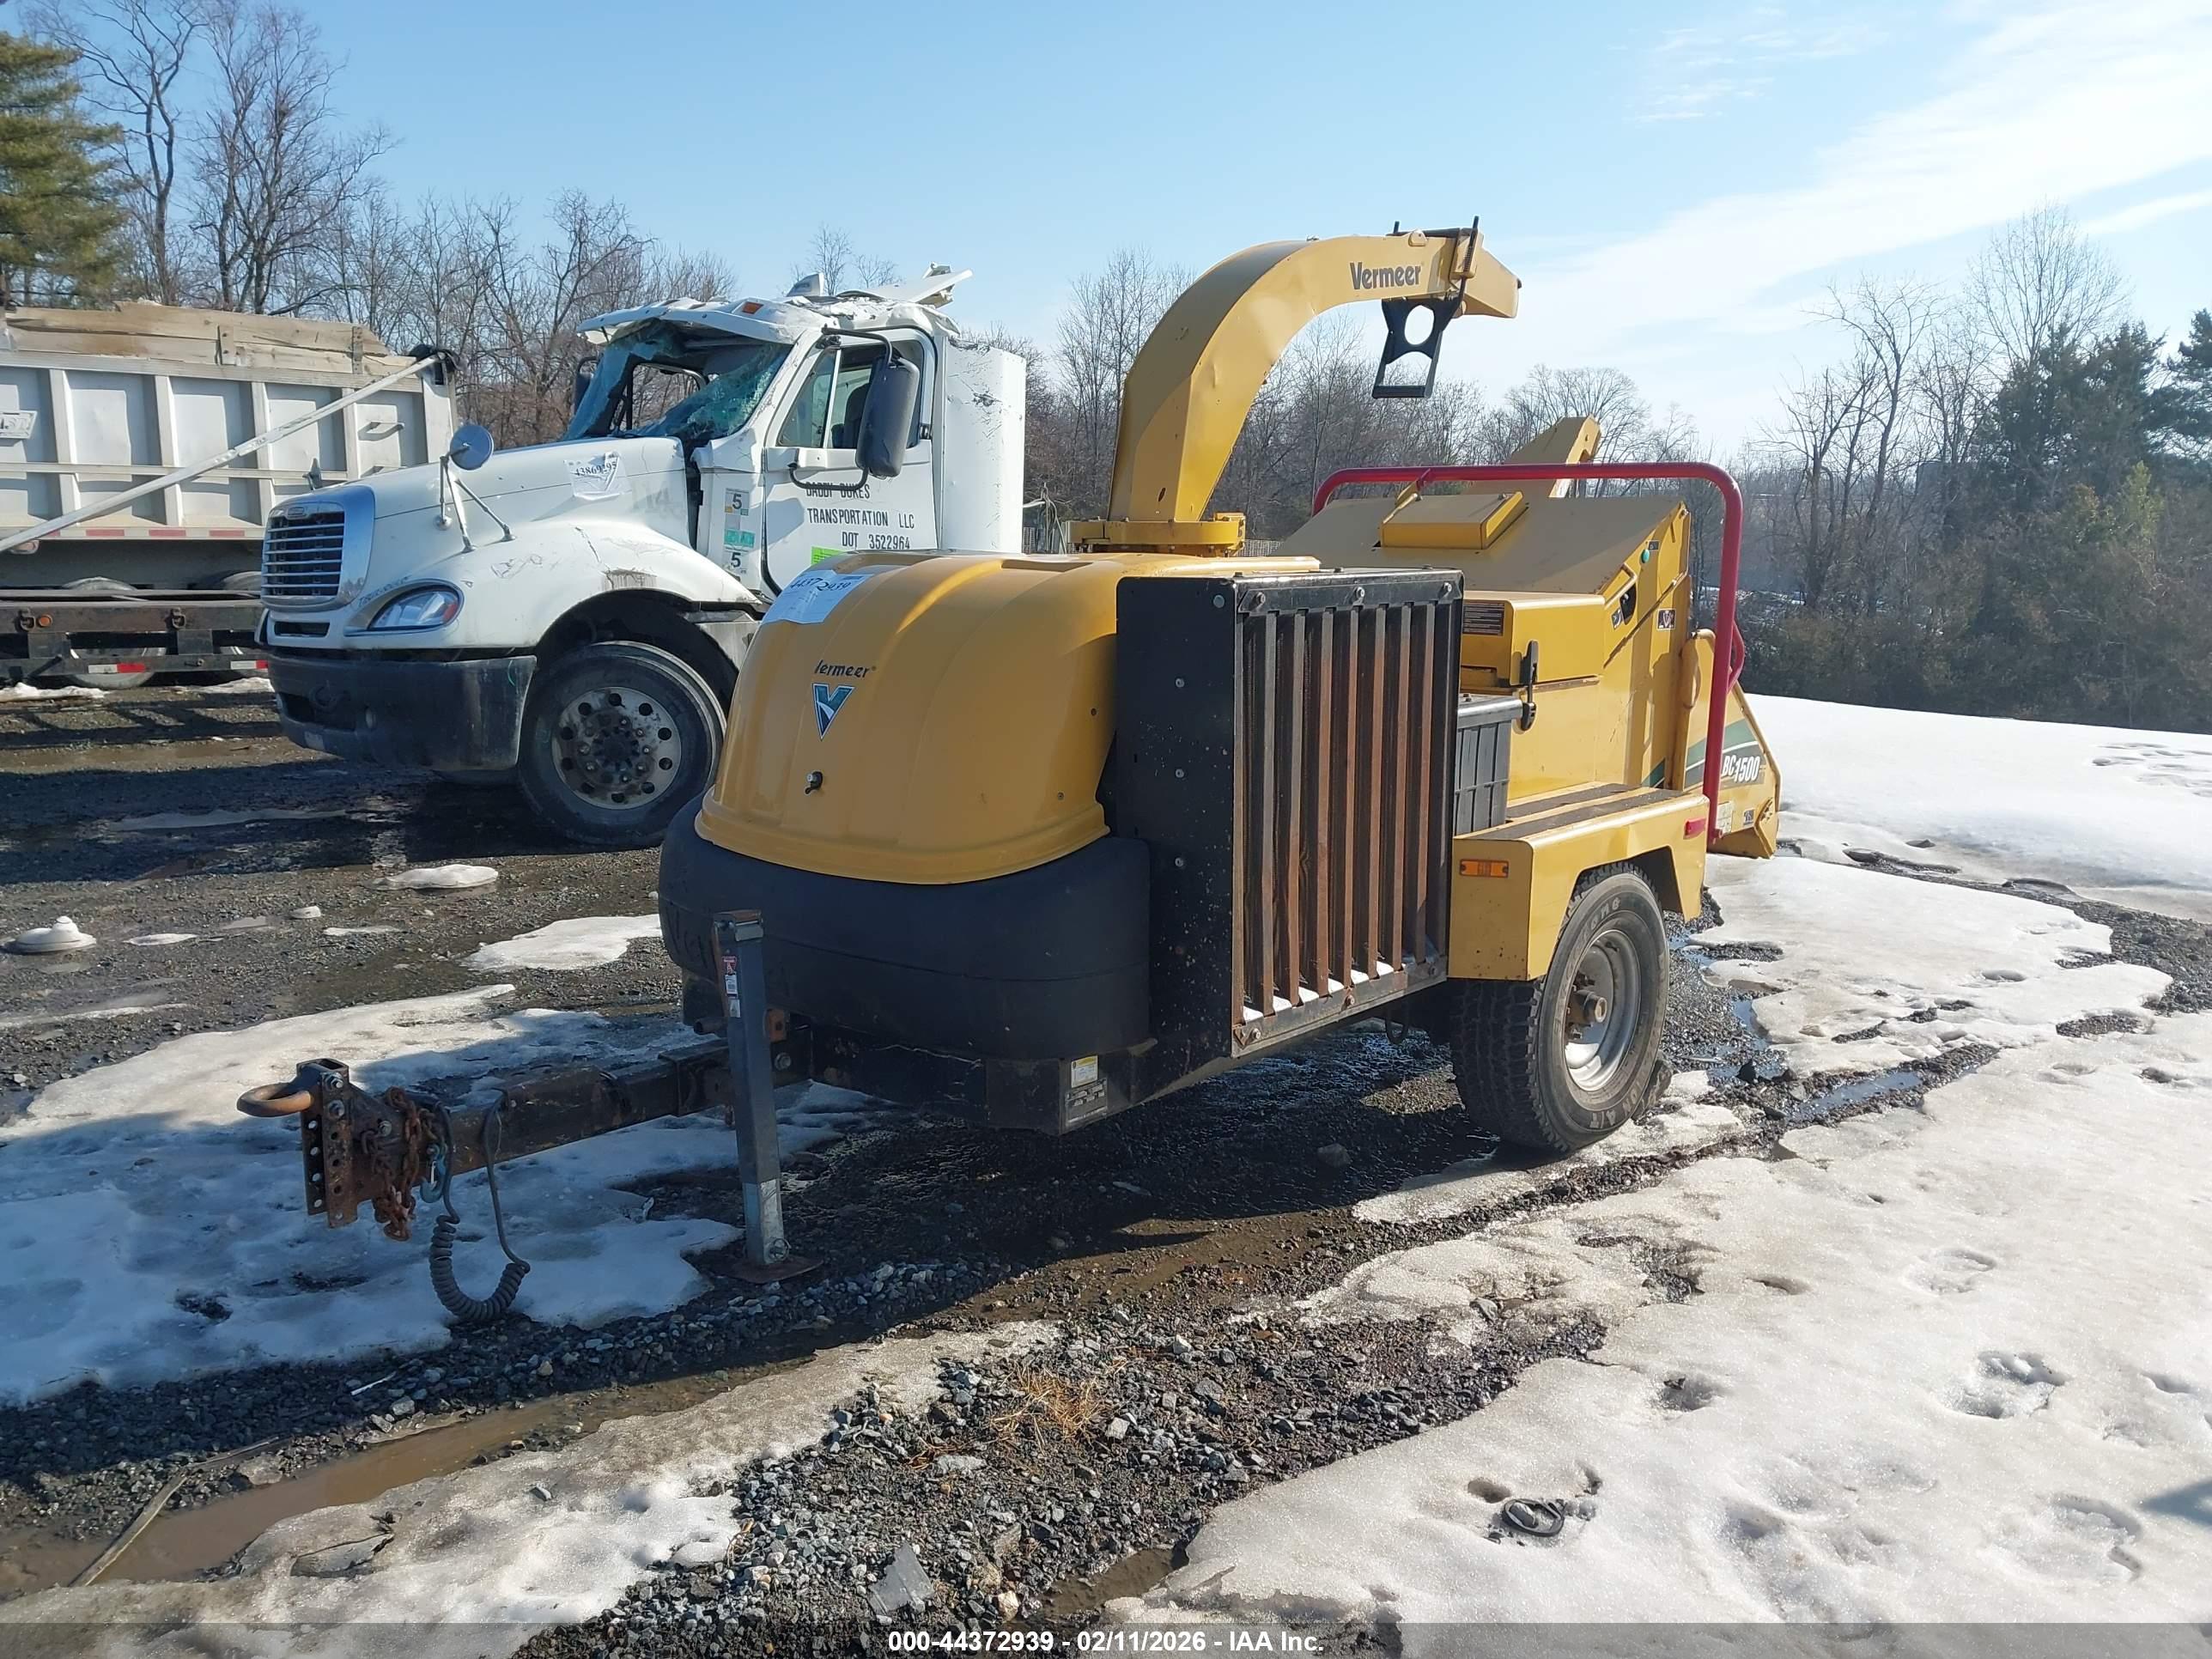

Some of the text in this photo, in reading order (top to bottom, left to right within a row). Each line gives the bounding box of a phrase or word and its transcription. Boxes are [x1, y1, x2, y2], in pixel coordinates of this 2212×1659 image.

[1349, 261, 1421, 290] Vermeer
[574, 459, 617, 477] 4386995
[732, 493, 742, 510] 5
[807, 507, 915, 529] TRANSPORTATION LLC
[842, 532, 910, 550] DOT 3522964
[731, 551, 741, 568] 5
[1721, 754, 1760, 783] BC1500
